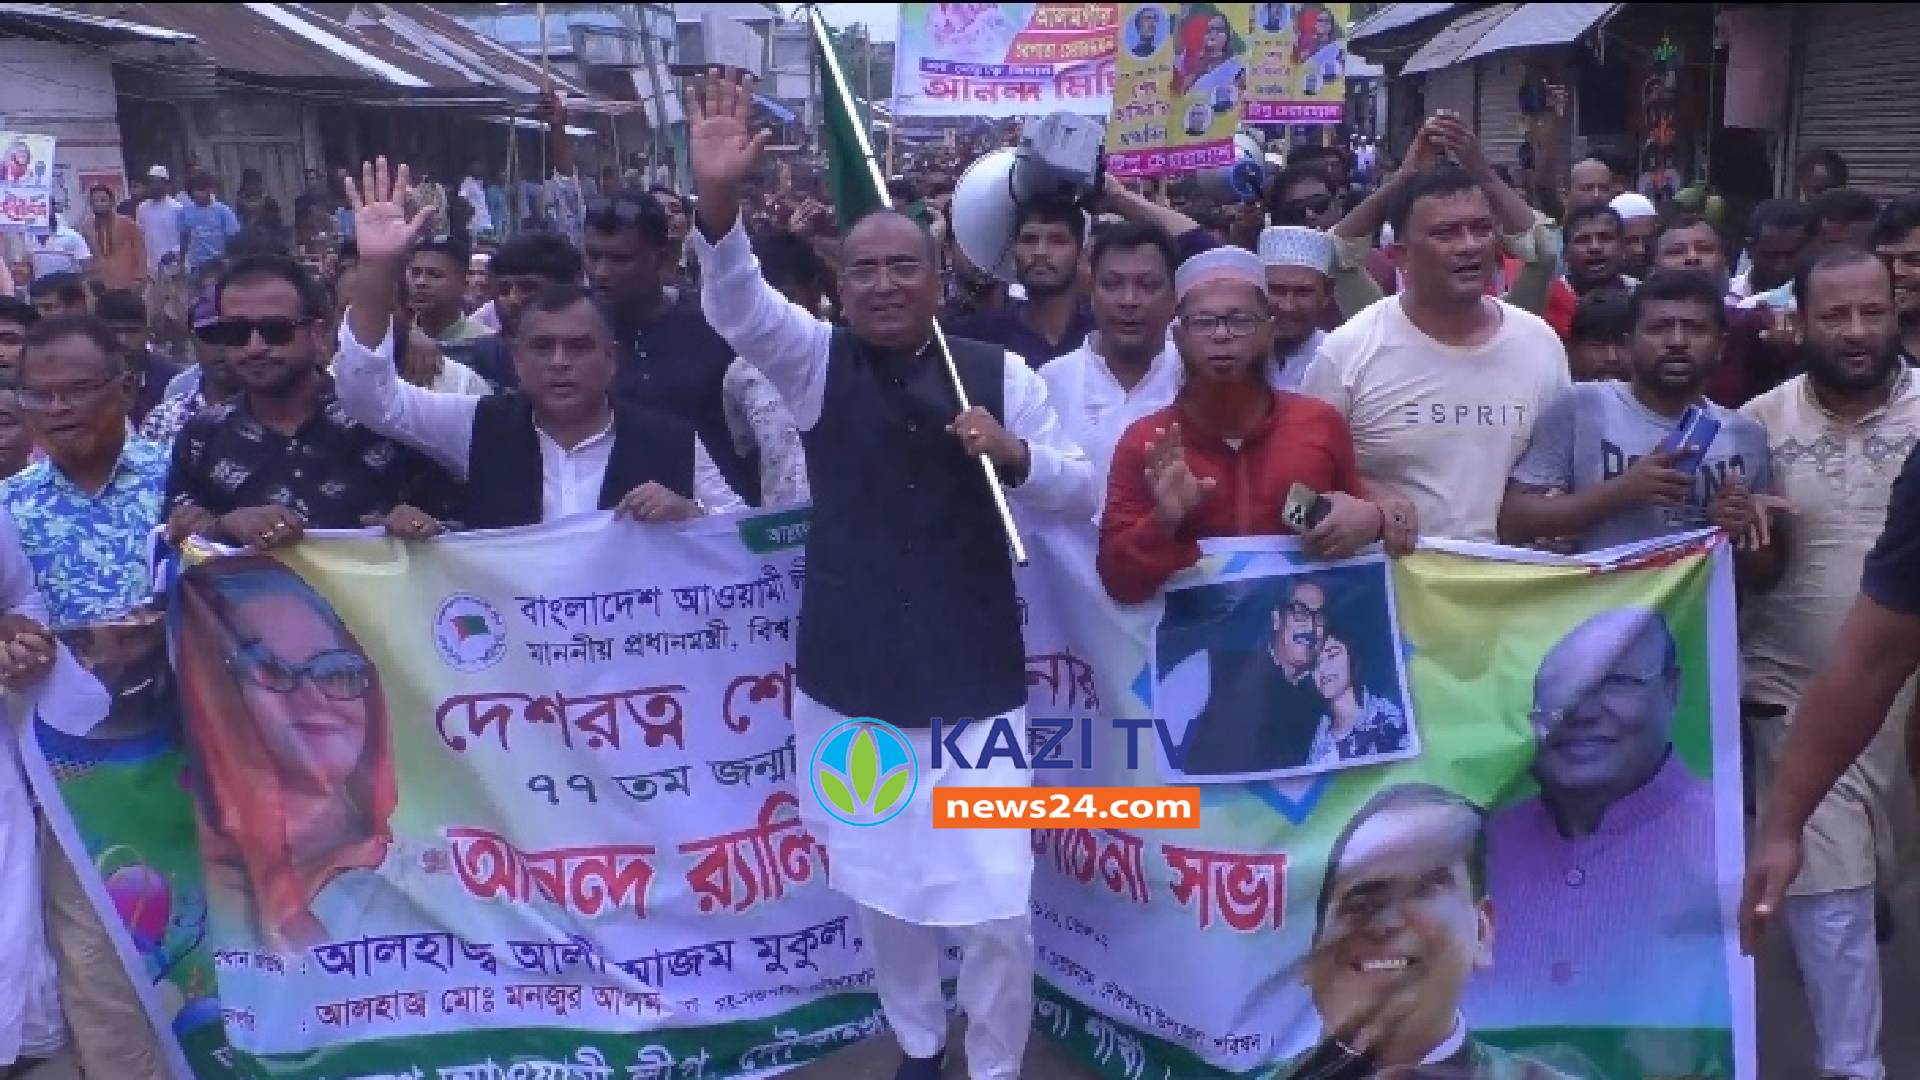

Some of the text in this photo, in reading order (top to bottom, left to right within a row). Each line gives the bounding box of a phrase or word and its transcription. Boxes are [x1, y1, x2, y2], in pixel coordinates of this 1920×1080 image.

[922, 75, 1042, 103] আনন্দ
[1404, 403, 1527, 426] ESPRIT
[515, 586, 662, 629] বাংলাদেশ
[671, 565, 786, 616] আওয়ামী
[526, 634, 613, 664] মাননীয়
[435, 685, 688, 751] দেশরত্ন
[723, 662, 796, 733] শে
[528, 774, 597, 804] ৭৭
[612, 766, 692, 800] তম
[446, 827, 656, 919] আনন্দ
[1161, 843, 1288, 933] সভা
[506, 932, 606, 976] আলী
[441, 986, 496, 1015] মোঃ
[505, 984, 582, 1018] মনজুর
